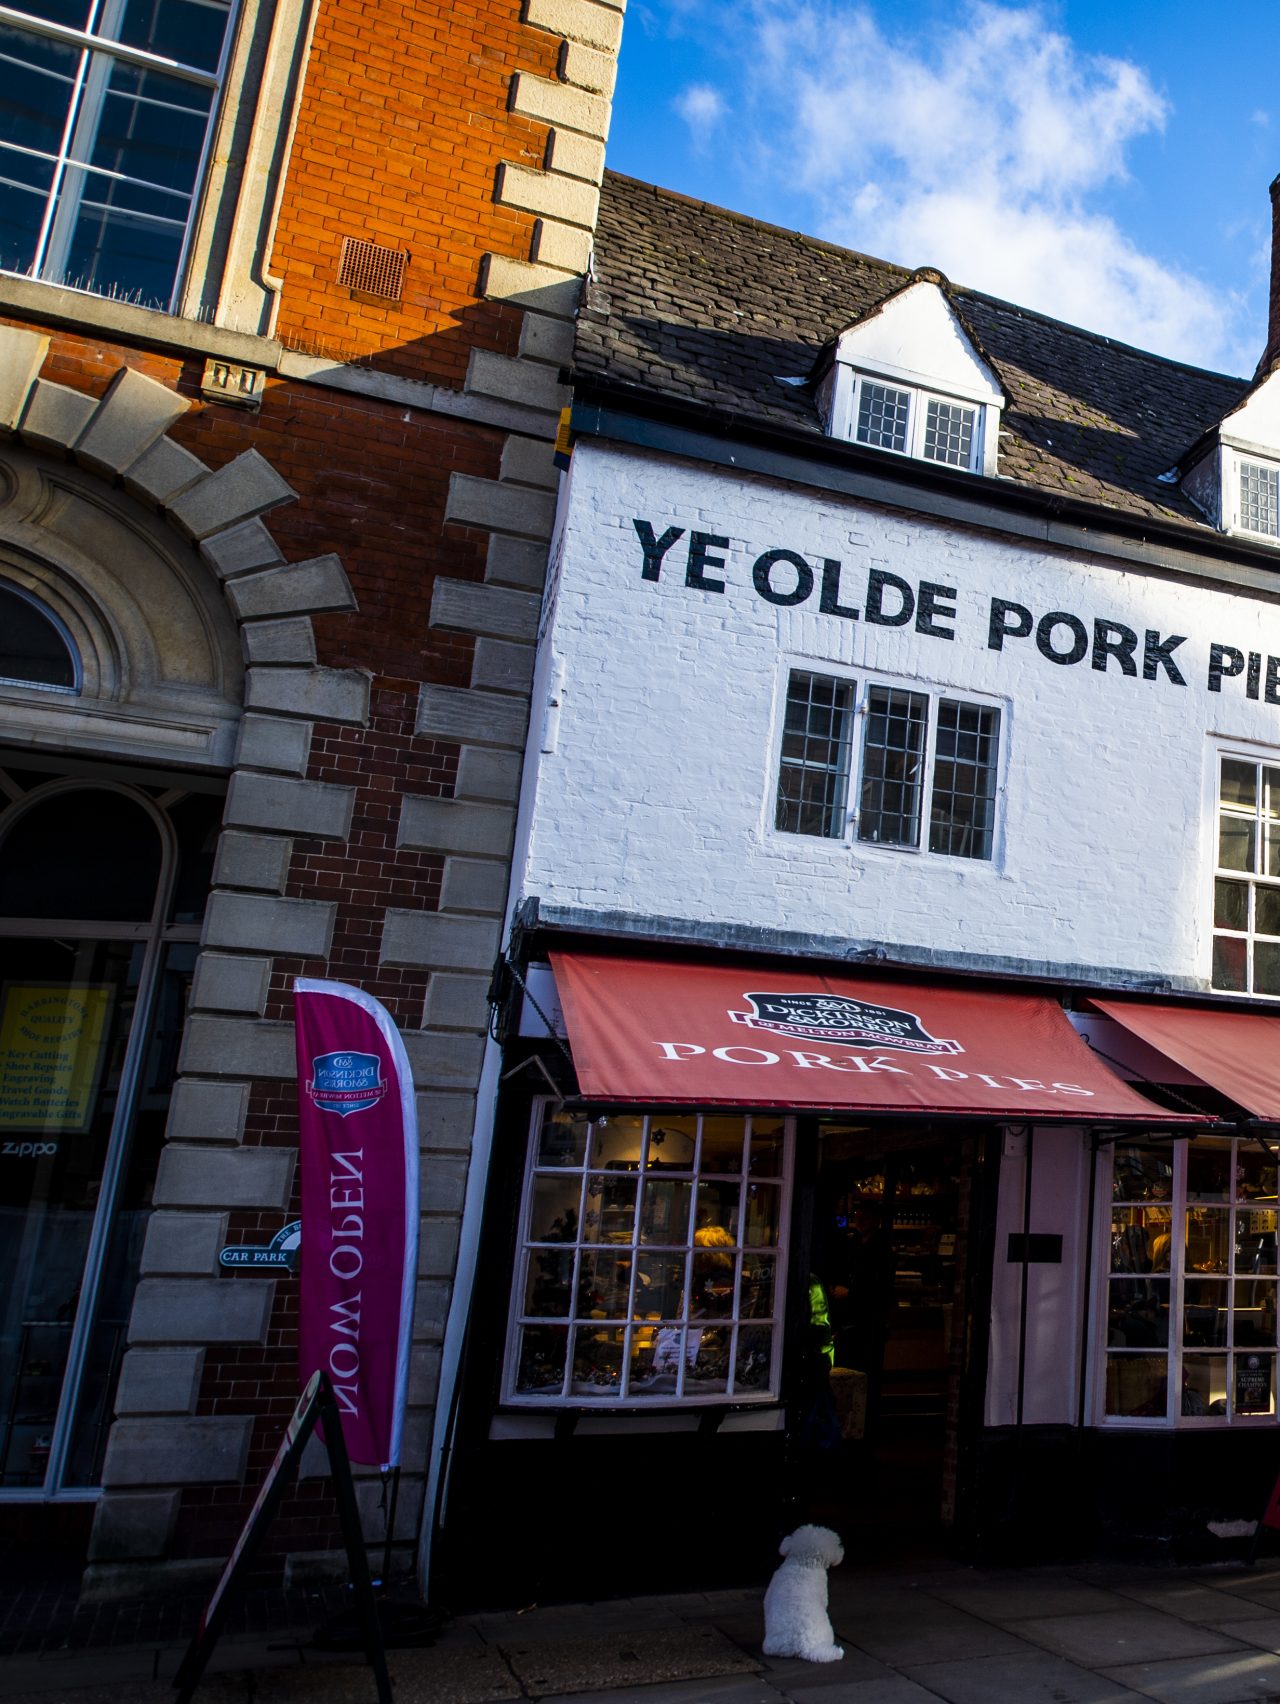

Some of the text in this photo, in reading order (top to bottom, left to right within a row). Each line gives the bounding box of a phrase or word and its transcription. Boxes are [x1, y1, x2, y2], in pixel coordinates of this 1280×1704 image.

[633, 519, 730, 593] YE
[752, 548, 957, 641] OLDE
[987, 597, 1188, 686] PORK
[763, 1003, 911, 1030] DICKINSON
[779, 1025, 856, 1038] MELTON
[861, 1031, 943, 1051] MOWBRAY
[29, 1050, 69, 1061] Cutting
[6, 1062, 73, 1073] Shoe Repairs
[651, 1041, 1096, 1097] PORK PIES
[3, 1074, 57, 1084] Engraving
[35, 1086, 69, 1095] Goods
[57, 1110, 81, 1118] Gifts
[222, 1252, 287, 1261] CAR PARK
